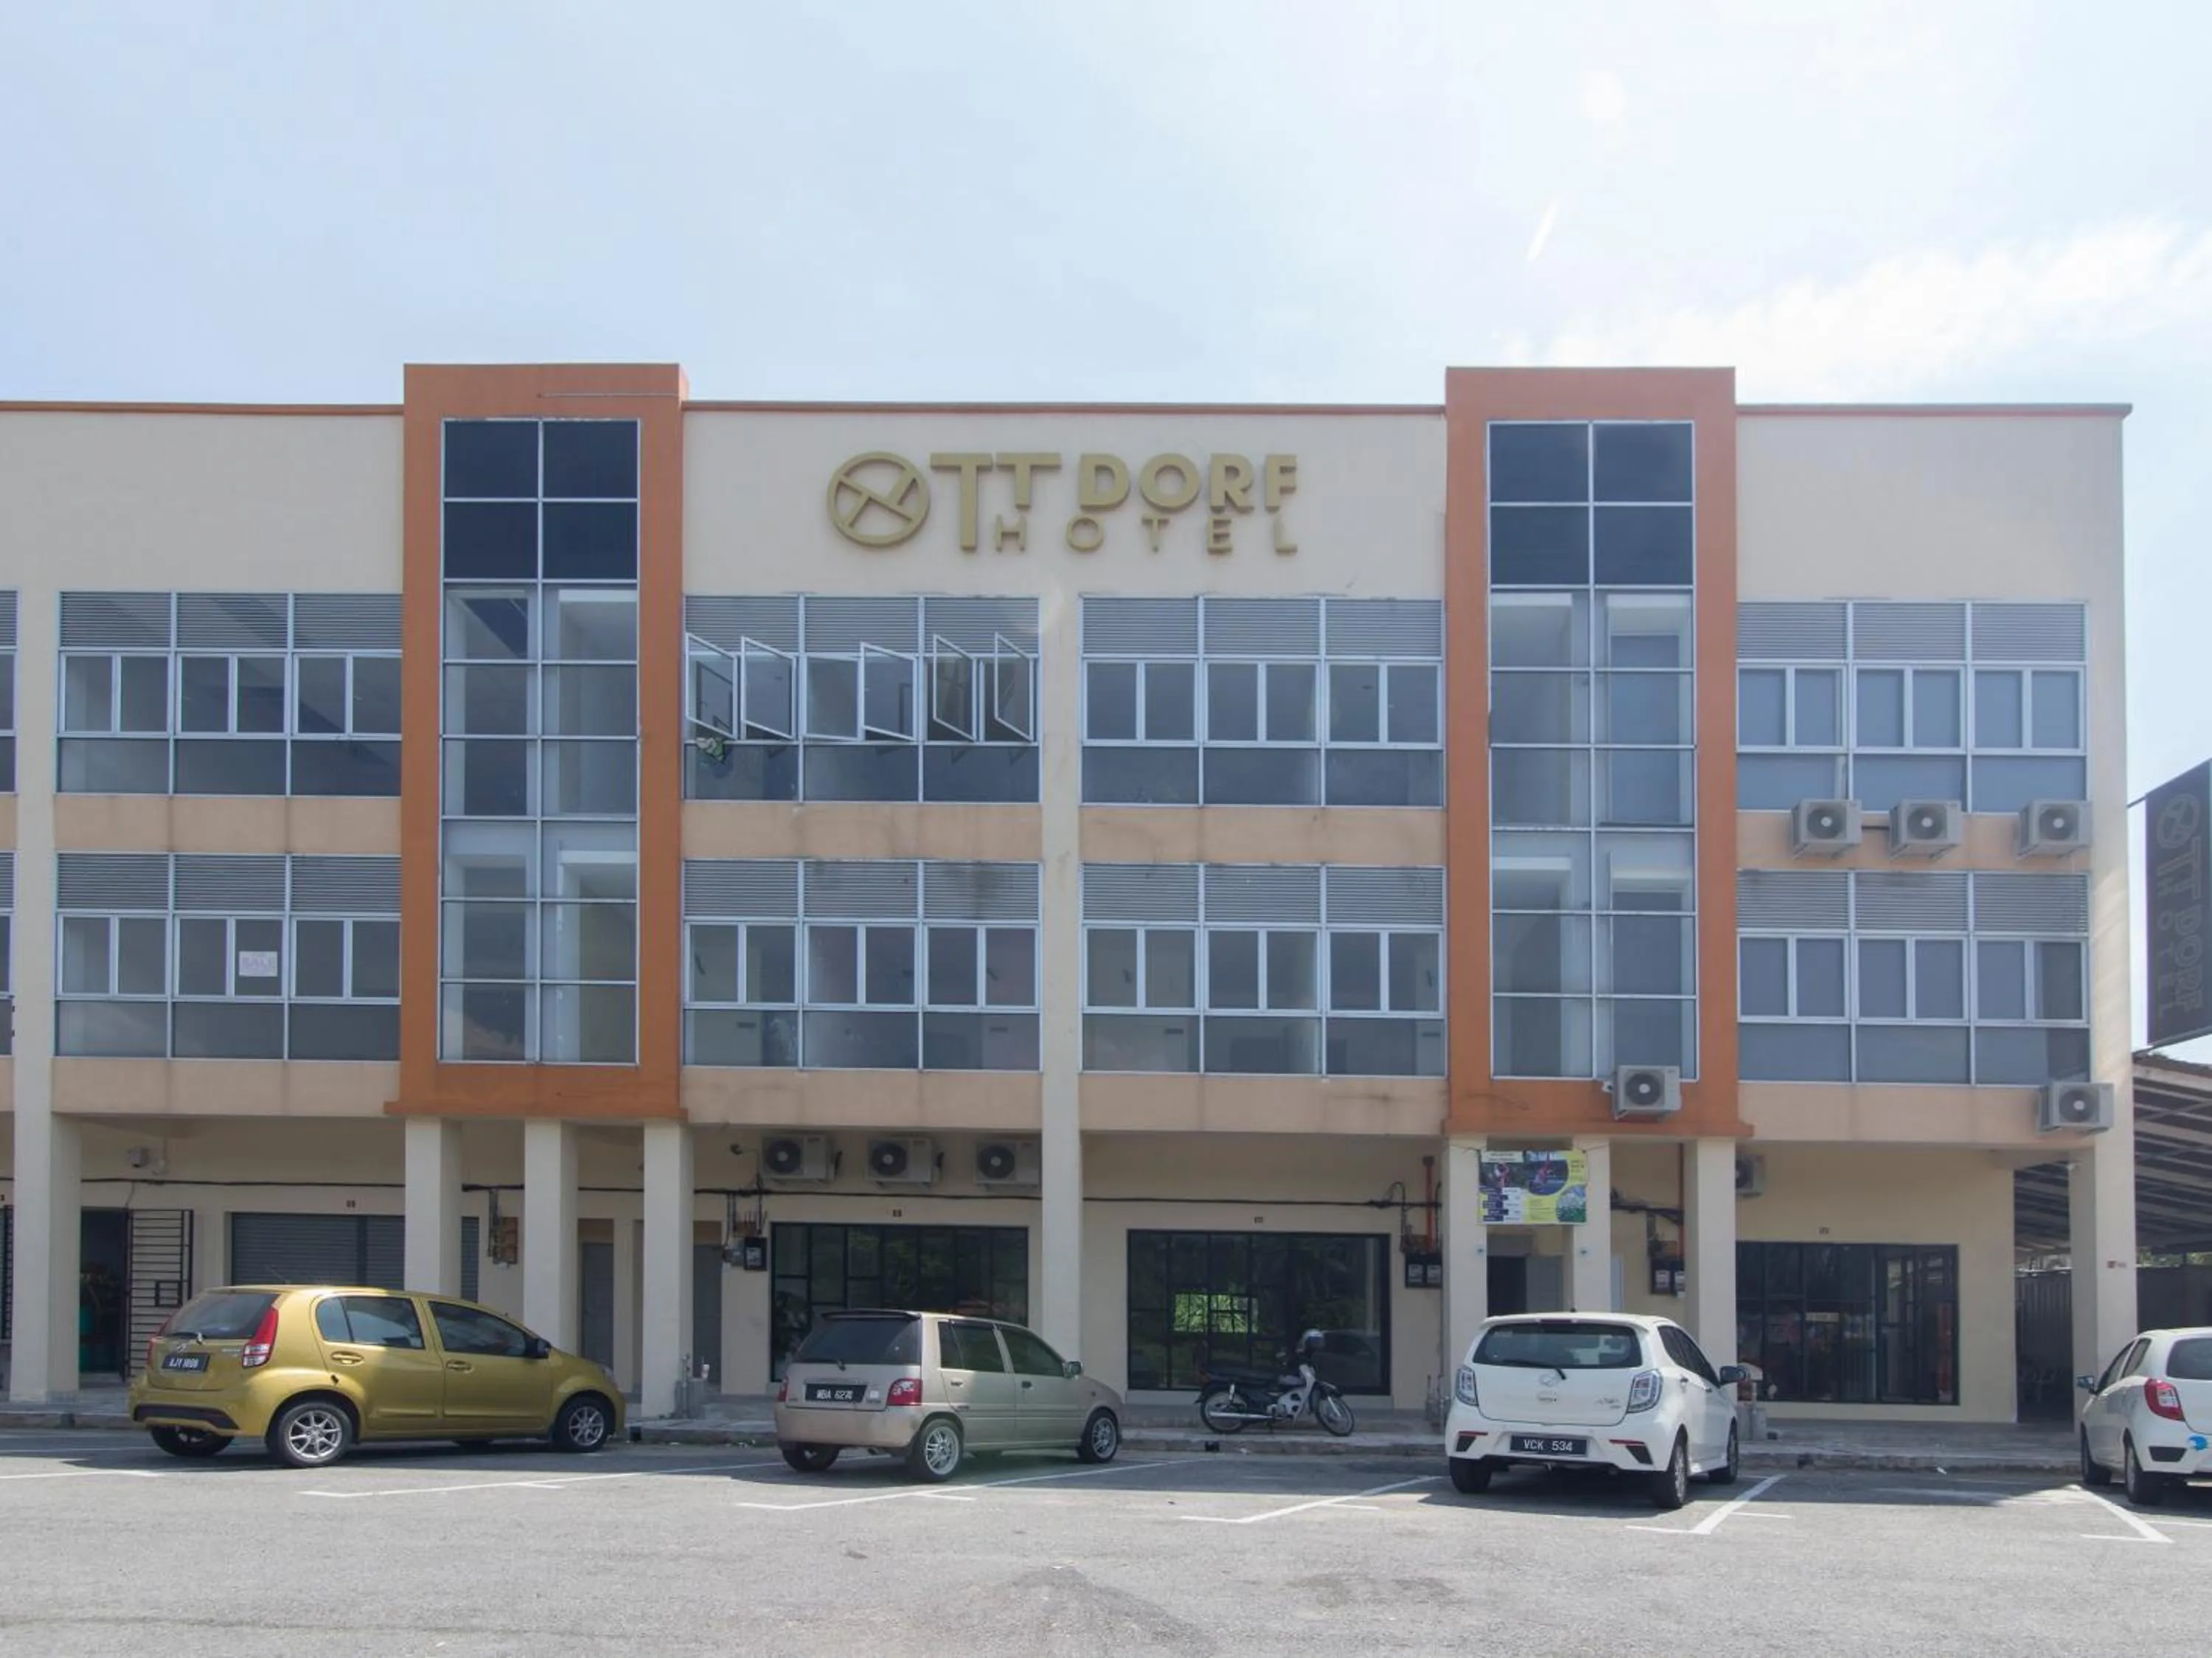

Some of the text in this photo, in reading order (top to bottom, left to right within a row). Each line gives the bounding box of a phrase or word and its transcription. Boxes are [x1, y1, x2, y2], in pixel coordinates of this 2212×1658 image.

[994, 515, 1298, 555] HOTEL
[1523, 1439, 1573, 1451] VCK 534
